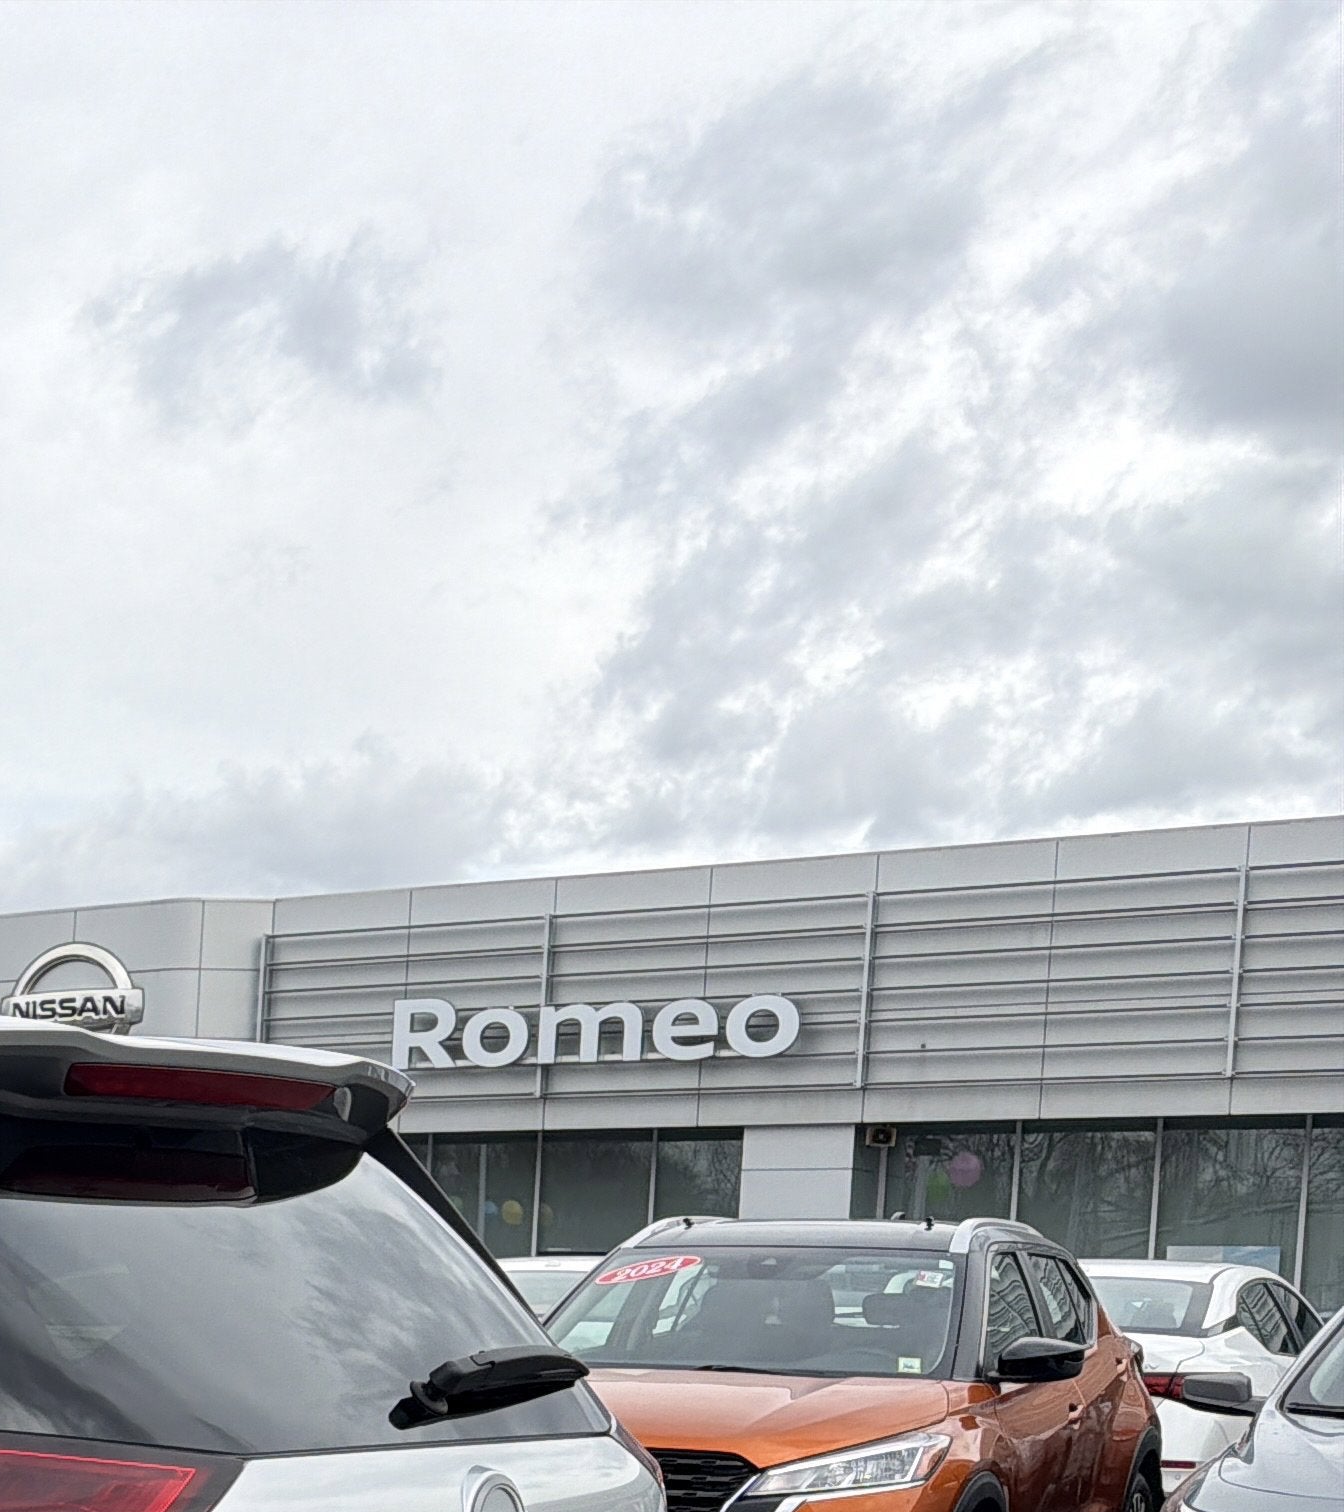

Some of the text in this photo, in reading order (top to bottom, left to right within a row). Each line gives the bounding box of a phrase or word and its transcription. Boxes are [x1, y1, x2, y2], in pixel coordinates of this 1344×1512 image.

[12, 995, 125, 1019] NISSAN
[391, 994, 800, 1070] Romeo
[611, 1256, 685, 1282] 2024
